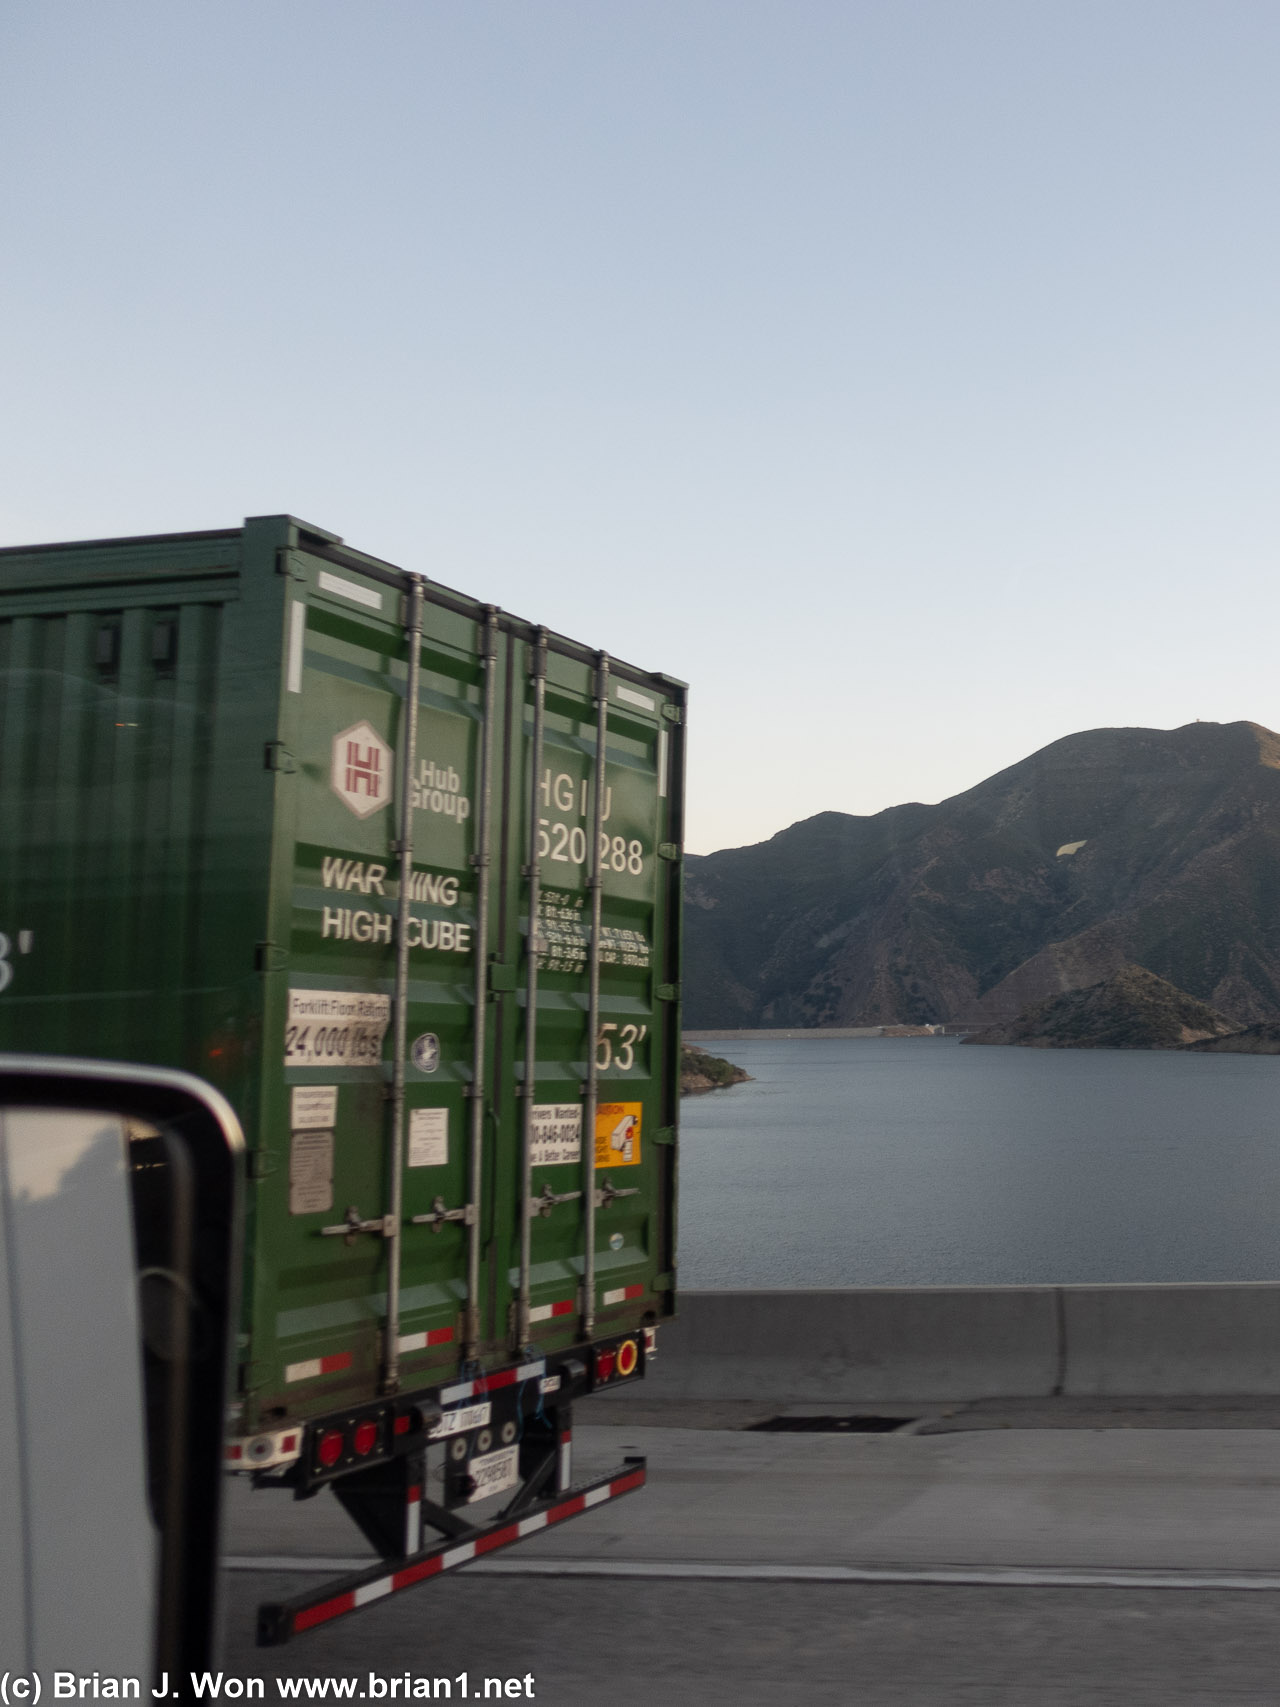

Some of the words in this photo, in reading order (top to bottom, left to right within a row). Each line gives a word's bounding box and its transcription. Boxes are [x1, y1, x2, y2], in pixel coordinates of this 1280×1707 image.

[411, 776, 470, 824] Group
[420, 758, 461, 794] Hub
[539, 818, 644, 875] 520288
[322, 905, 393, 945] HIGH
[406, 916, 471, 953] CUBE
[293, 998, 329, 1015] Forklift
[331, 1000, 356, 1016] Floor
[358, 1001, 388, 1021] Rating
[286, 1025, 350, 1061] 24,000
[351, 1027, 380, 1058] lbs
[595, 1022, 647, 1071] 53'
